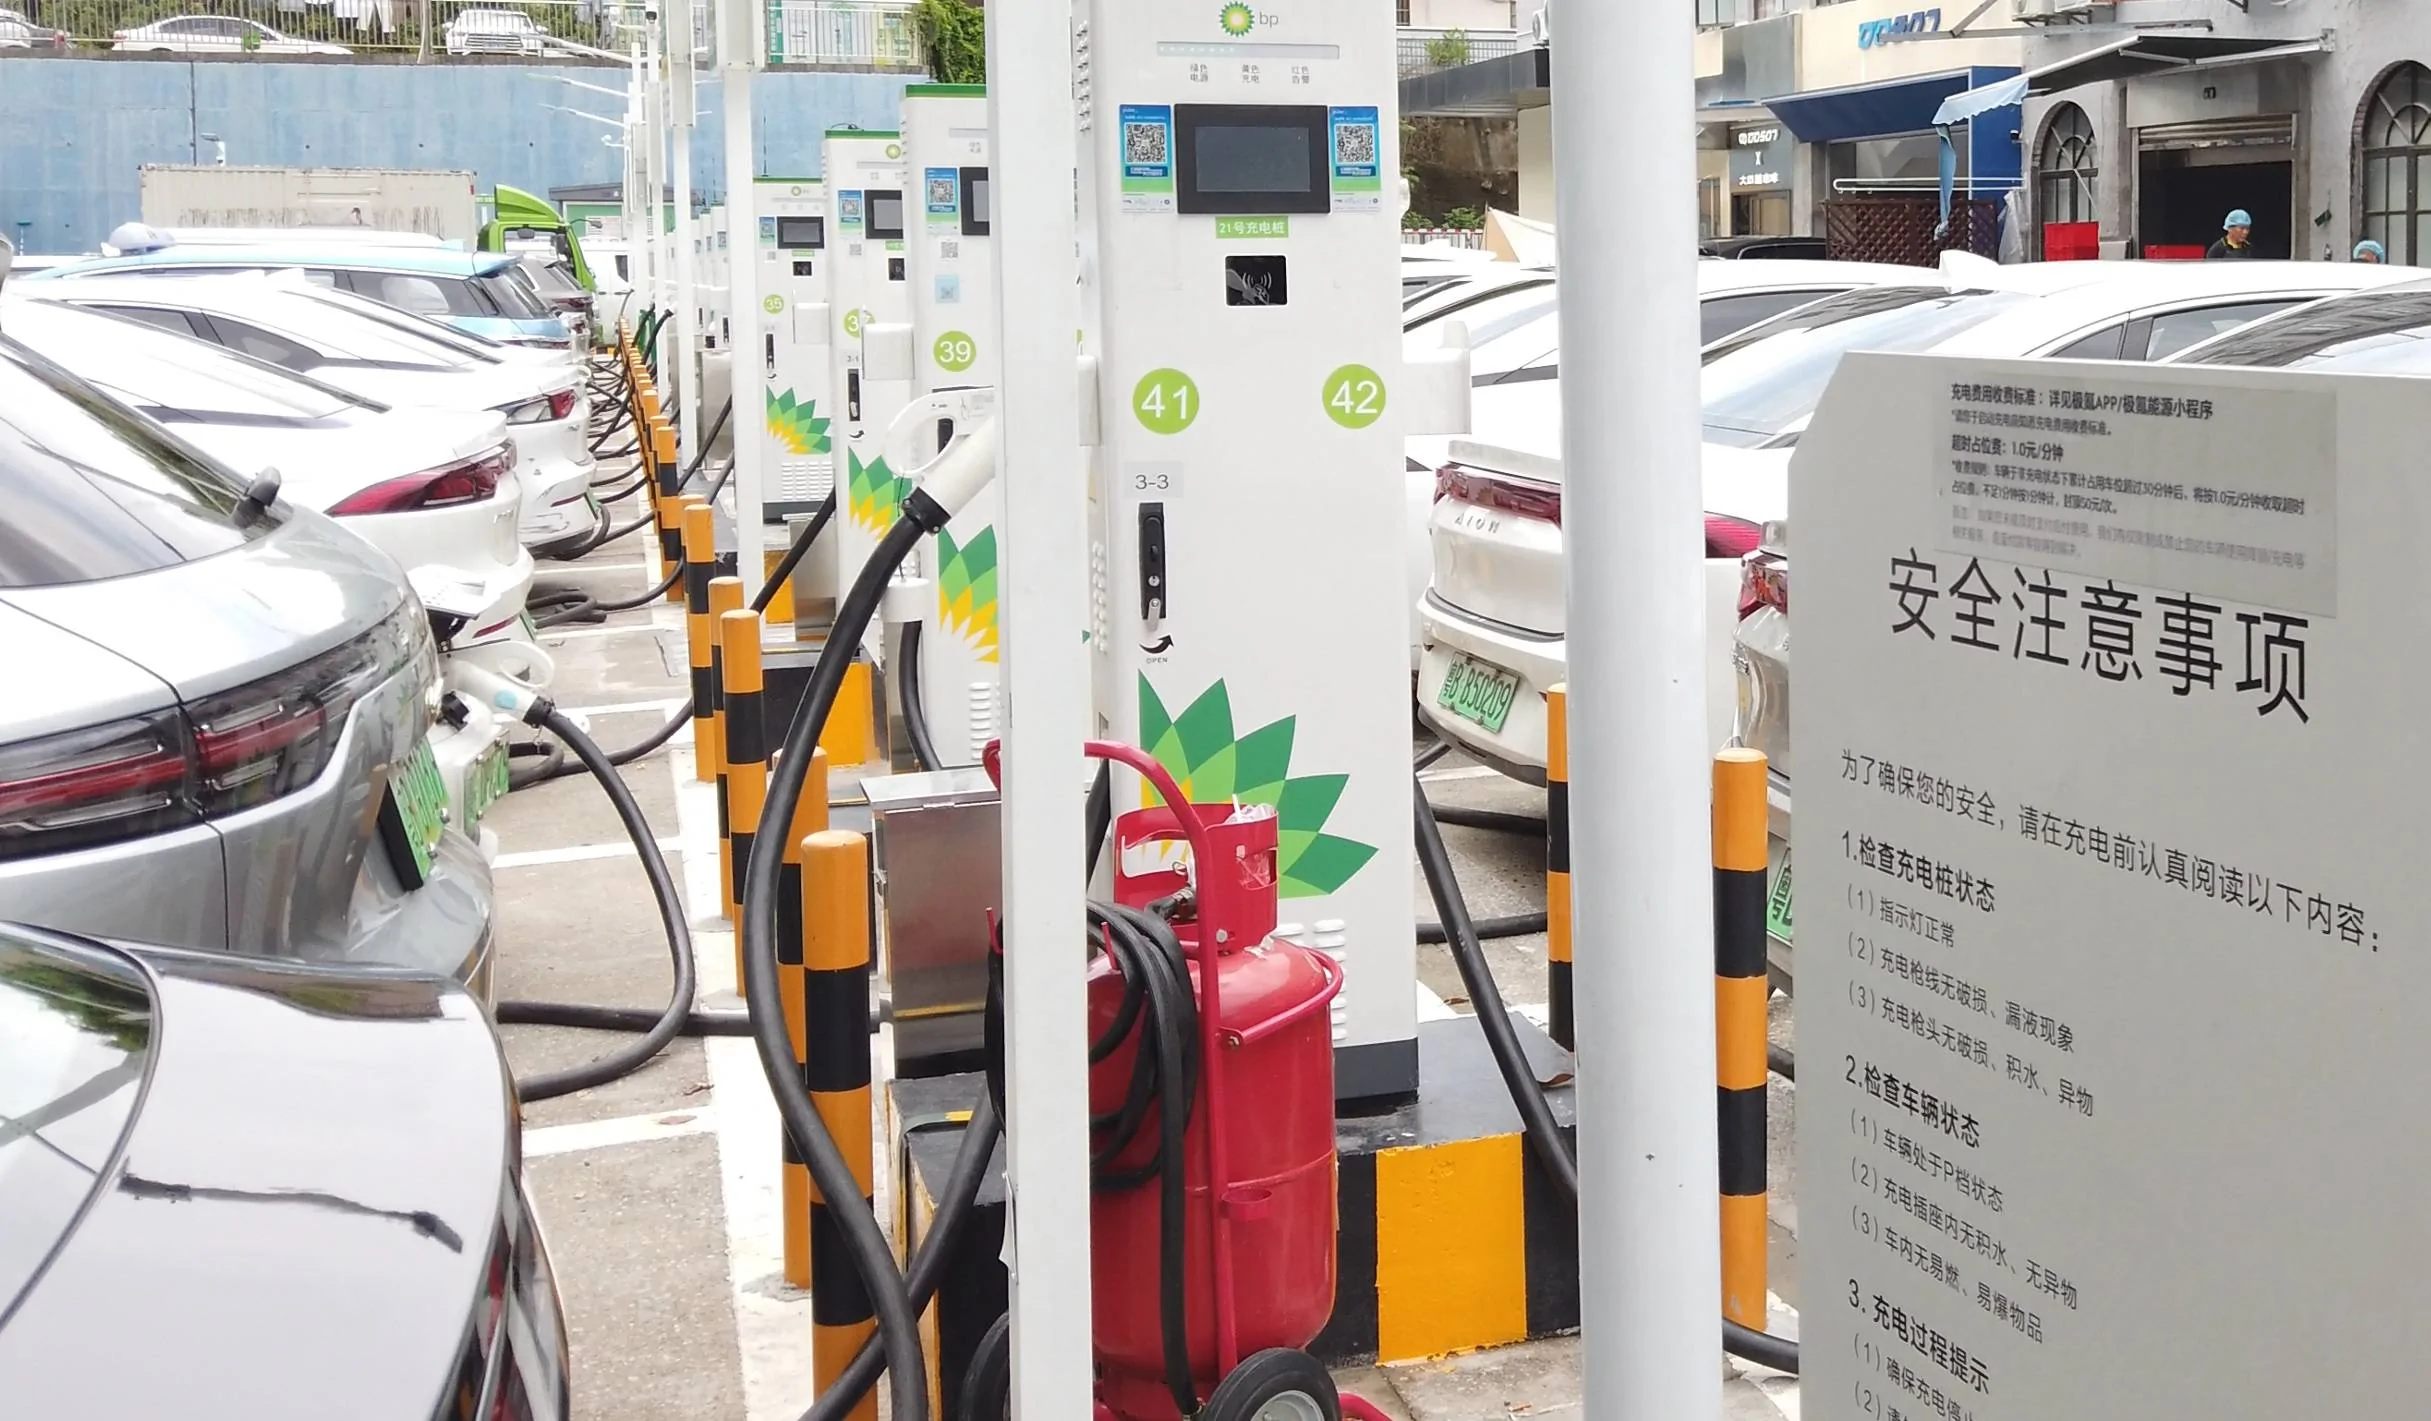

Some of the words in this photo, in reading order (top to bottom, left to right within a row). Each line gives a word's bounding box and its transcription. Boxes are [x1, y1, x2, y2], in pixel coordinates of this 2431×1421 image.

[1259, 12, 1279, 28] bp
[1218, 221, 1285, 236] 21号充电桩
[938, 340, 972, 363] 39
[1140, 384, 1188, 421] 41
[1330, 380, 1378, 415] 42
[1135, 474, 1170, 491] 3-3
[1888, 546, 2310, 725] 安全注意事项
[1841, 748, 2380, 953] 为了确保您的安全，请在充电前认真阅读以下内容：
[1842, 829, 1997, 914] 1.检查充电桩状态
[1845, 1055, 1982, 1150] 2.检查车辆状态
